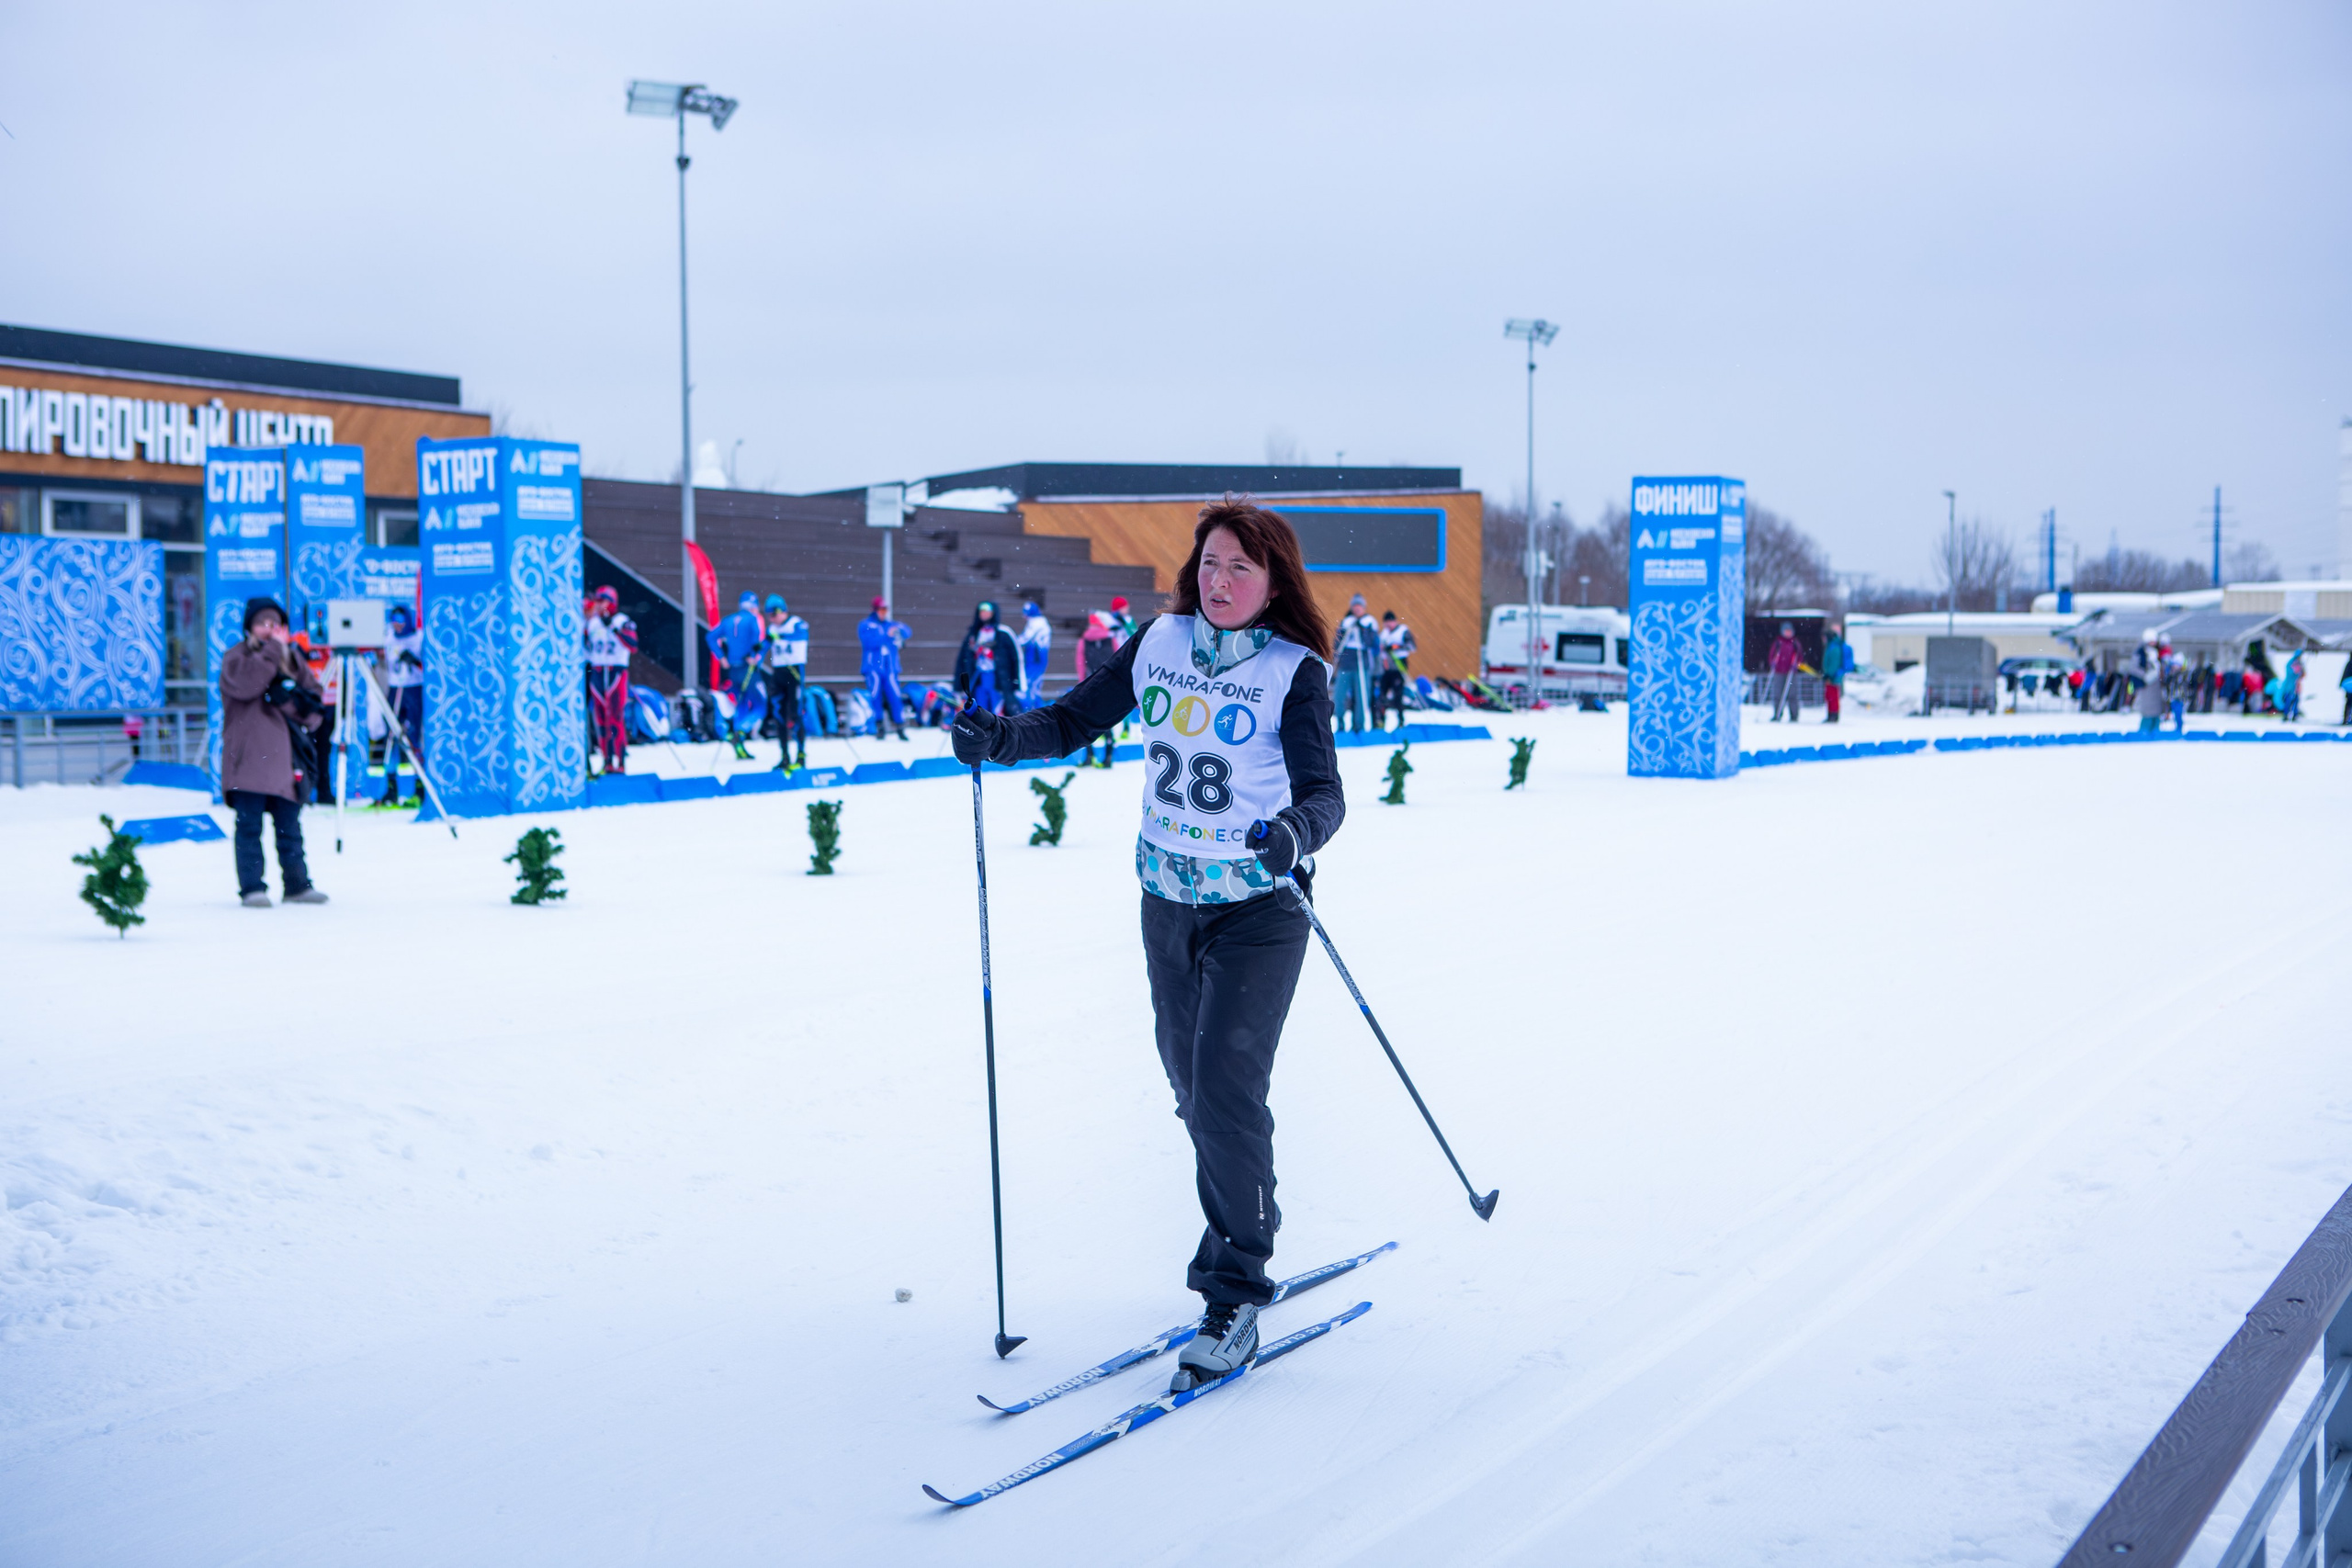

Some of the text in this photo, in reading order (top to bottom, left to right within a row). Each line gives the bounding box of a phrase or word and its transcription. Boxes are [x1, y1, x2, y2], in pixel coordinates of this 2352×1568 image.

[423, 446, 498, 496] СТАРТ
[1634, 484, 1718, 515] ФИНИШ
[1148, 663, 1264, 704] VMARAFONE
[1148, 740, 1234, 816] 28
[1287, 1260, 1352, 1285] XC CLASSIC
[1256, 1325, 1325, 1356] XC CLASSIC
[1028, 1367, 1106, 1407] NORDWAY
[1193, 1377, 1222, 1398] NORDWAY
[979, 1452, 1065, 1499] NORDWAY
